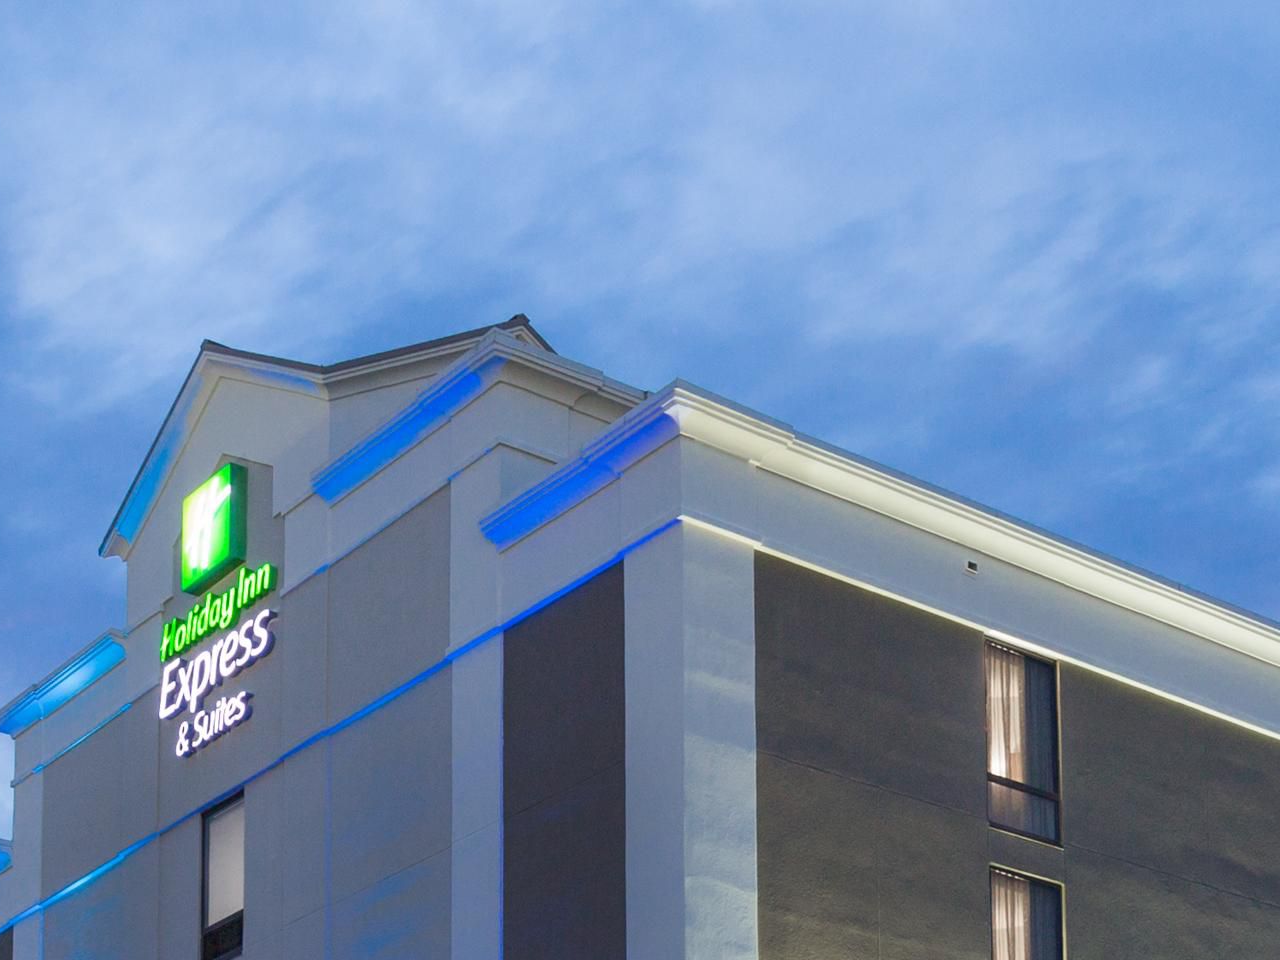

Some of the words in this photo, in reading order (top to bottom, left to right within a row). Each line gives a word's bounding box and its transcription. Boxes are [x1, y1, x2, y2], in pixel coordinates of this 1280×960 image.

[160, 584, 236, 662] Holiday
[236, 562, 271, 608] Inn
[159, 608, 271, 720] Express
[175, 720, 190, 758] &
[192, 690, 246, 748] Suites
